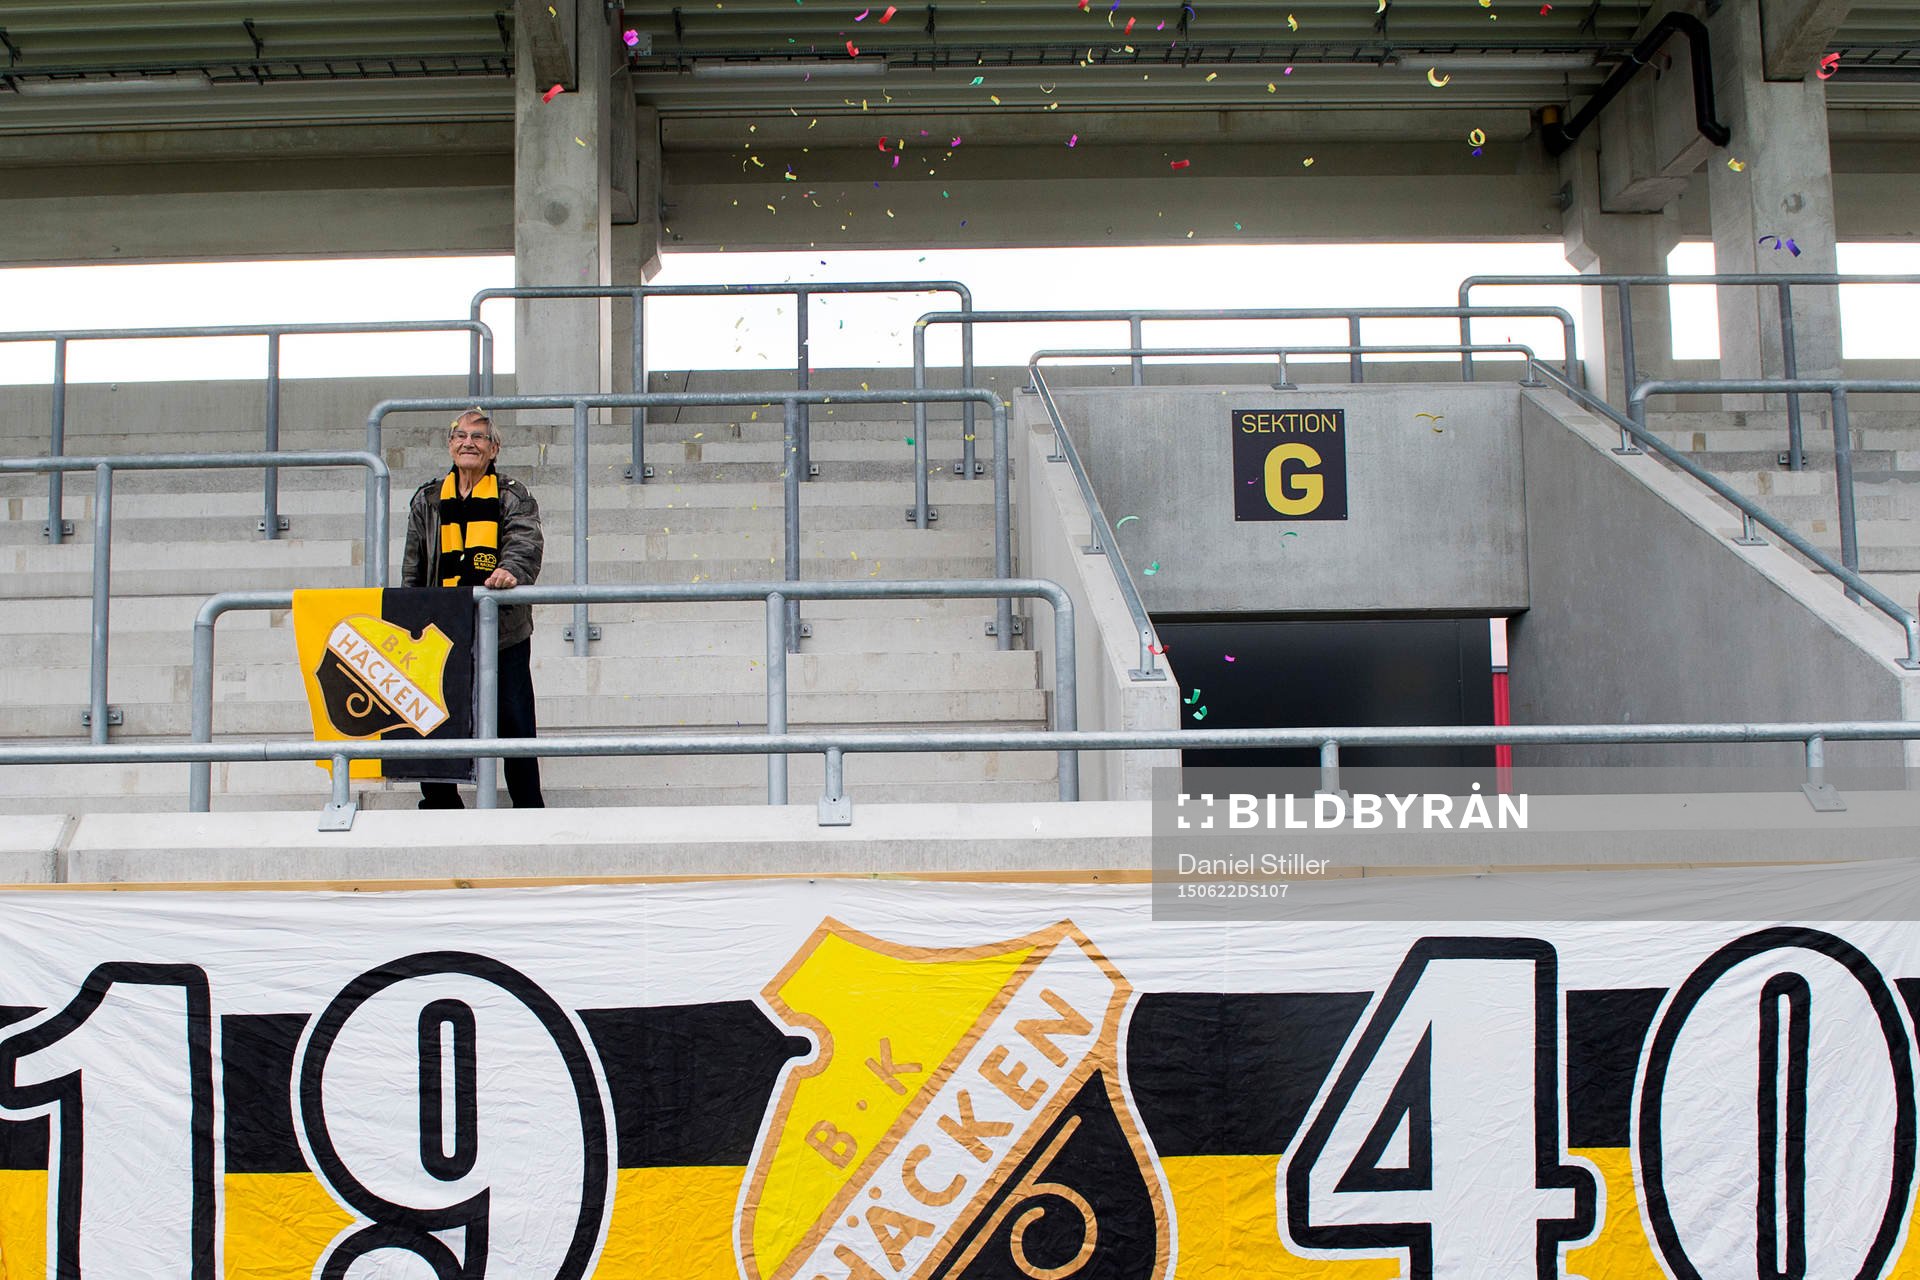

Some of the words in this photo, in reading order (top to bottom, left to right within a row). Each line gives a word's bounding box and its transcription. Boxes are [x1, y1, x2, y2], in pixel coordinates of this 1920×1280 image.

[1242, 413, 1336, 433] SEKTION
[1264, 442, 1324, 516] G
[337, 632, 430, 722] HÄCKEN
